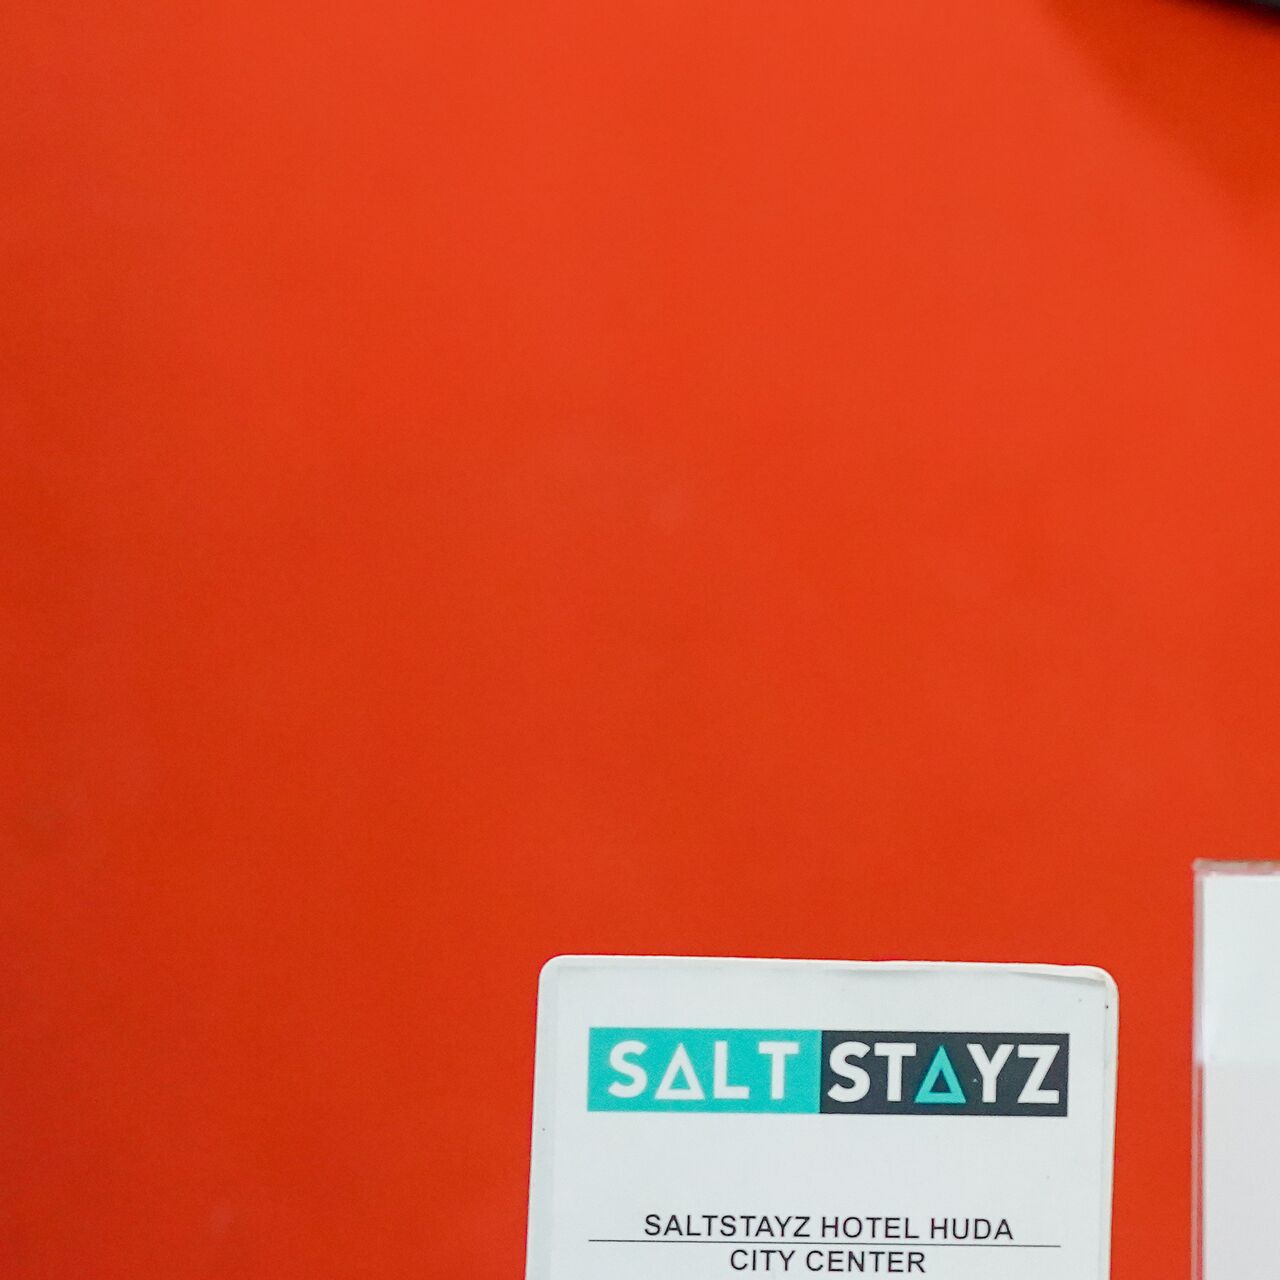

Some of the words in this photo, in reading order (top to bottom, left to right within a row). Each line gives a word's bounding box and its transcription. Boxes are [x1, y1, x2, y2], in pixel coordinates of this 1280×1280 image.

[607, 1040, 799, 1101] SALT
[827, 1041, 1060, 1105] STAYZ
[644, 1213, 811, 1239] SALTSTAYZ
[820, 1215, 920, 1240] HOTEL
[930, 1217, 1014, 1241] HUDA
[730, 1249, 794, 1273] CITY
[806, 1250, 926, 1274] CENTER
